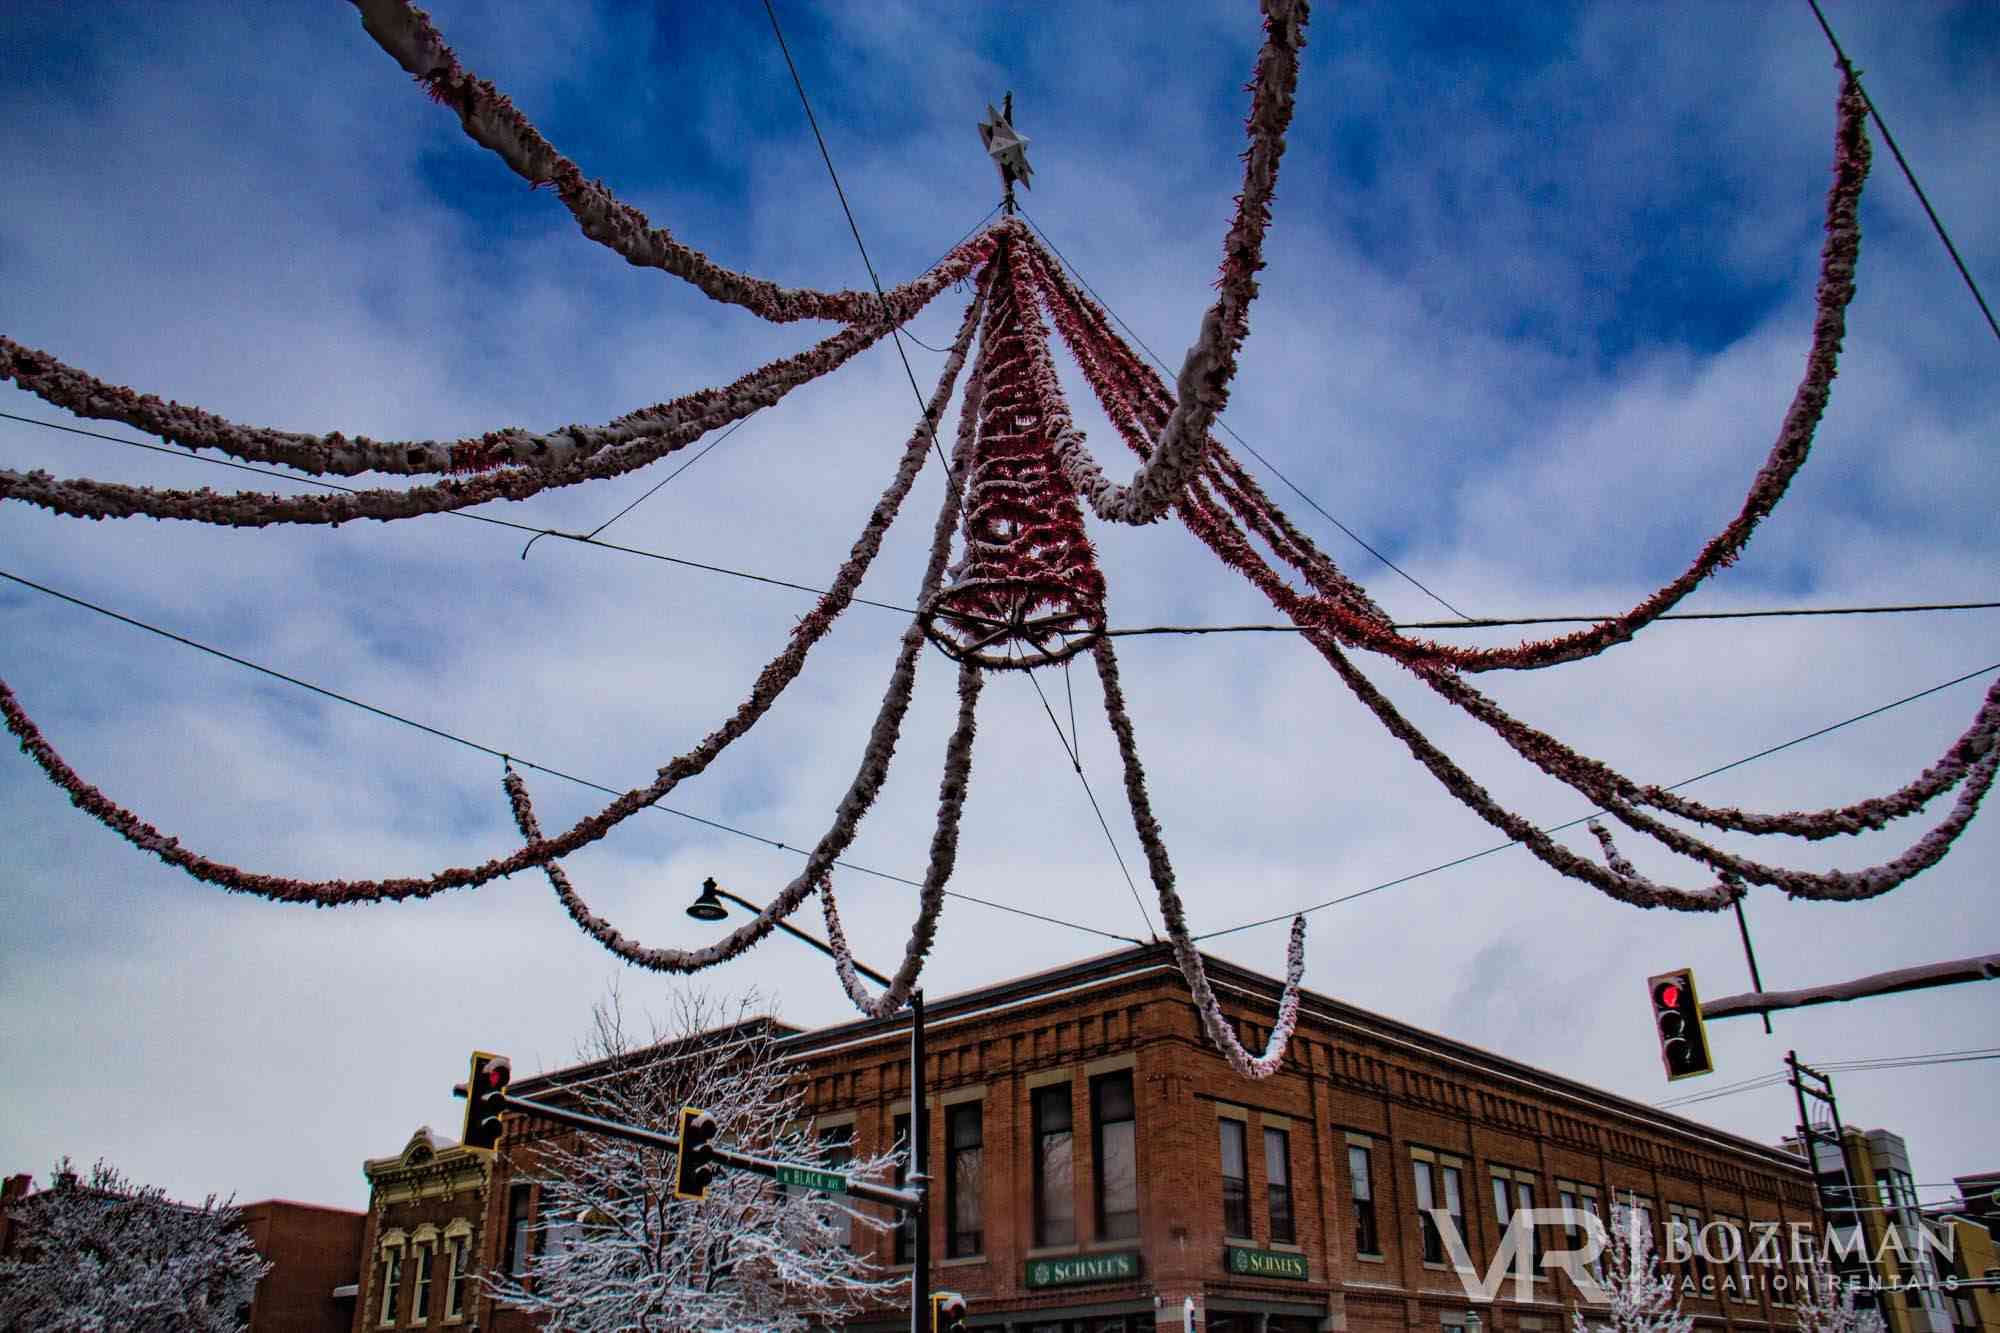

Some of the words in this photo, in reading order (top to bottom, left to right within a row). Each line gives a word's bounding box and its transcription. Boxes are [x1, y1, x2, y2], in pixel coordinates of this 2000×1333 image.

[794, 1170, 822, 1186] BLACK
[1054, 1256, 1129, 1281] SCHNEE'S
[1250, 1254, 1302, 1276] SCHNEE'S
